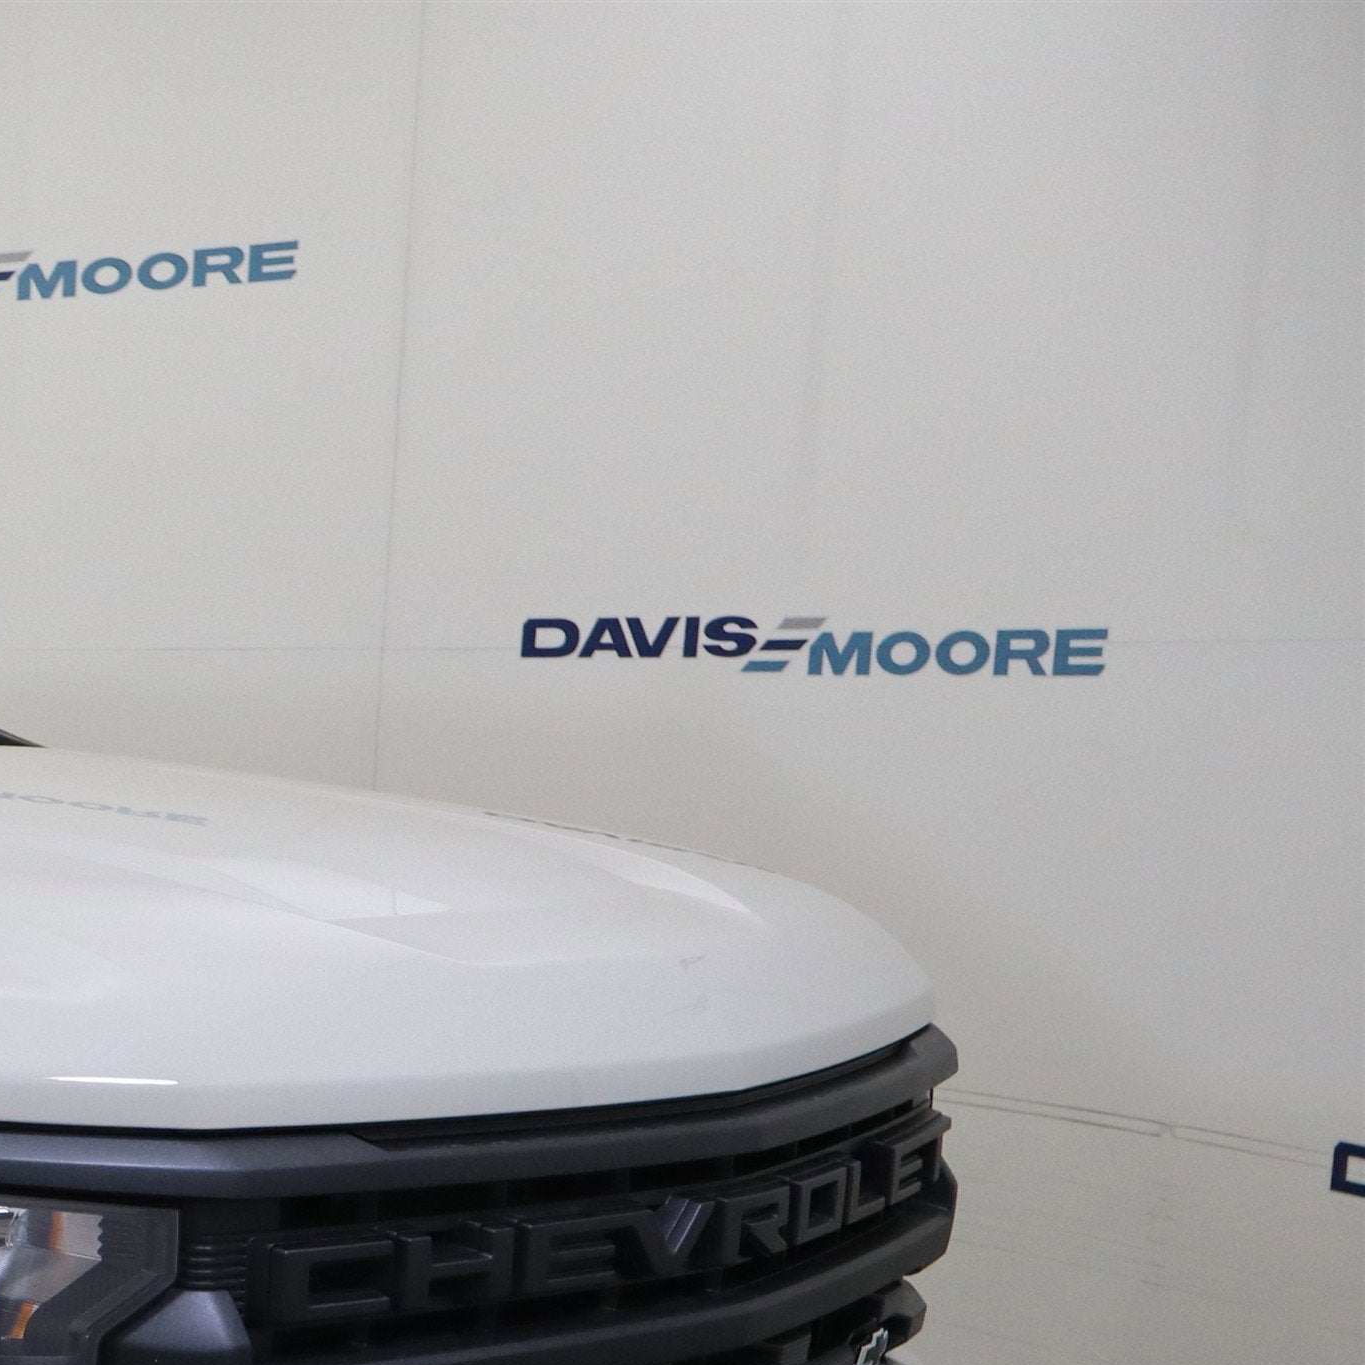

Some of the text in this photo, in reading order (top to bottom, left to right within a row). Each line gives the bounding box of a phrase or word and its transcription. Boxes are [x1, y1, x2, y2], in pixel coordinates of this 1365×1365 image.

[16, 240, 300, 301] MOORE
[520, 615, 1109, 676] DAVIS MOORE
